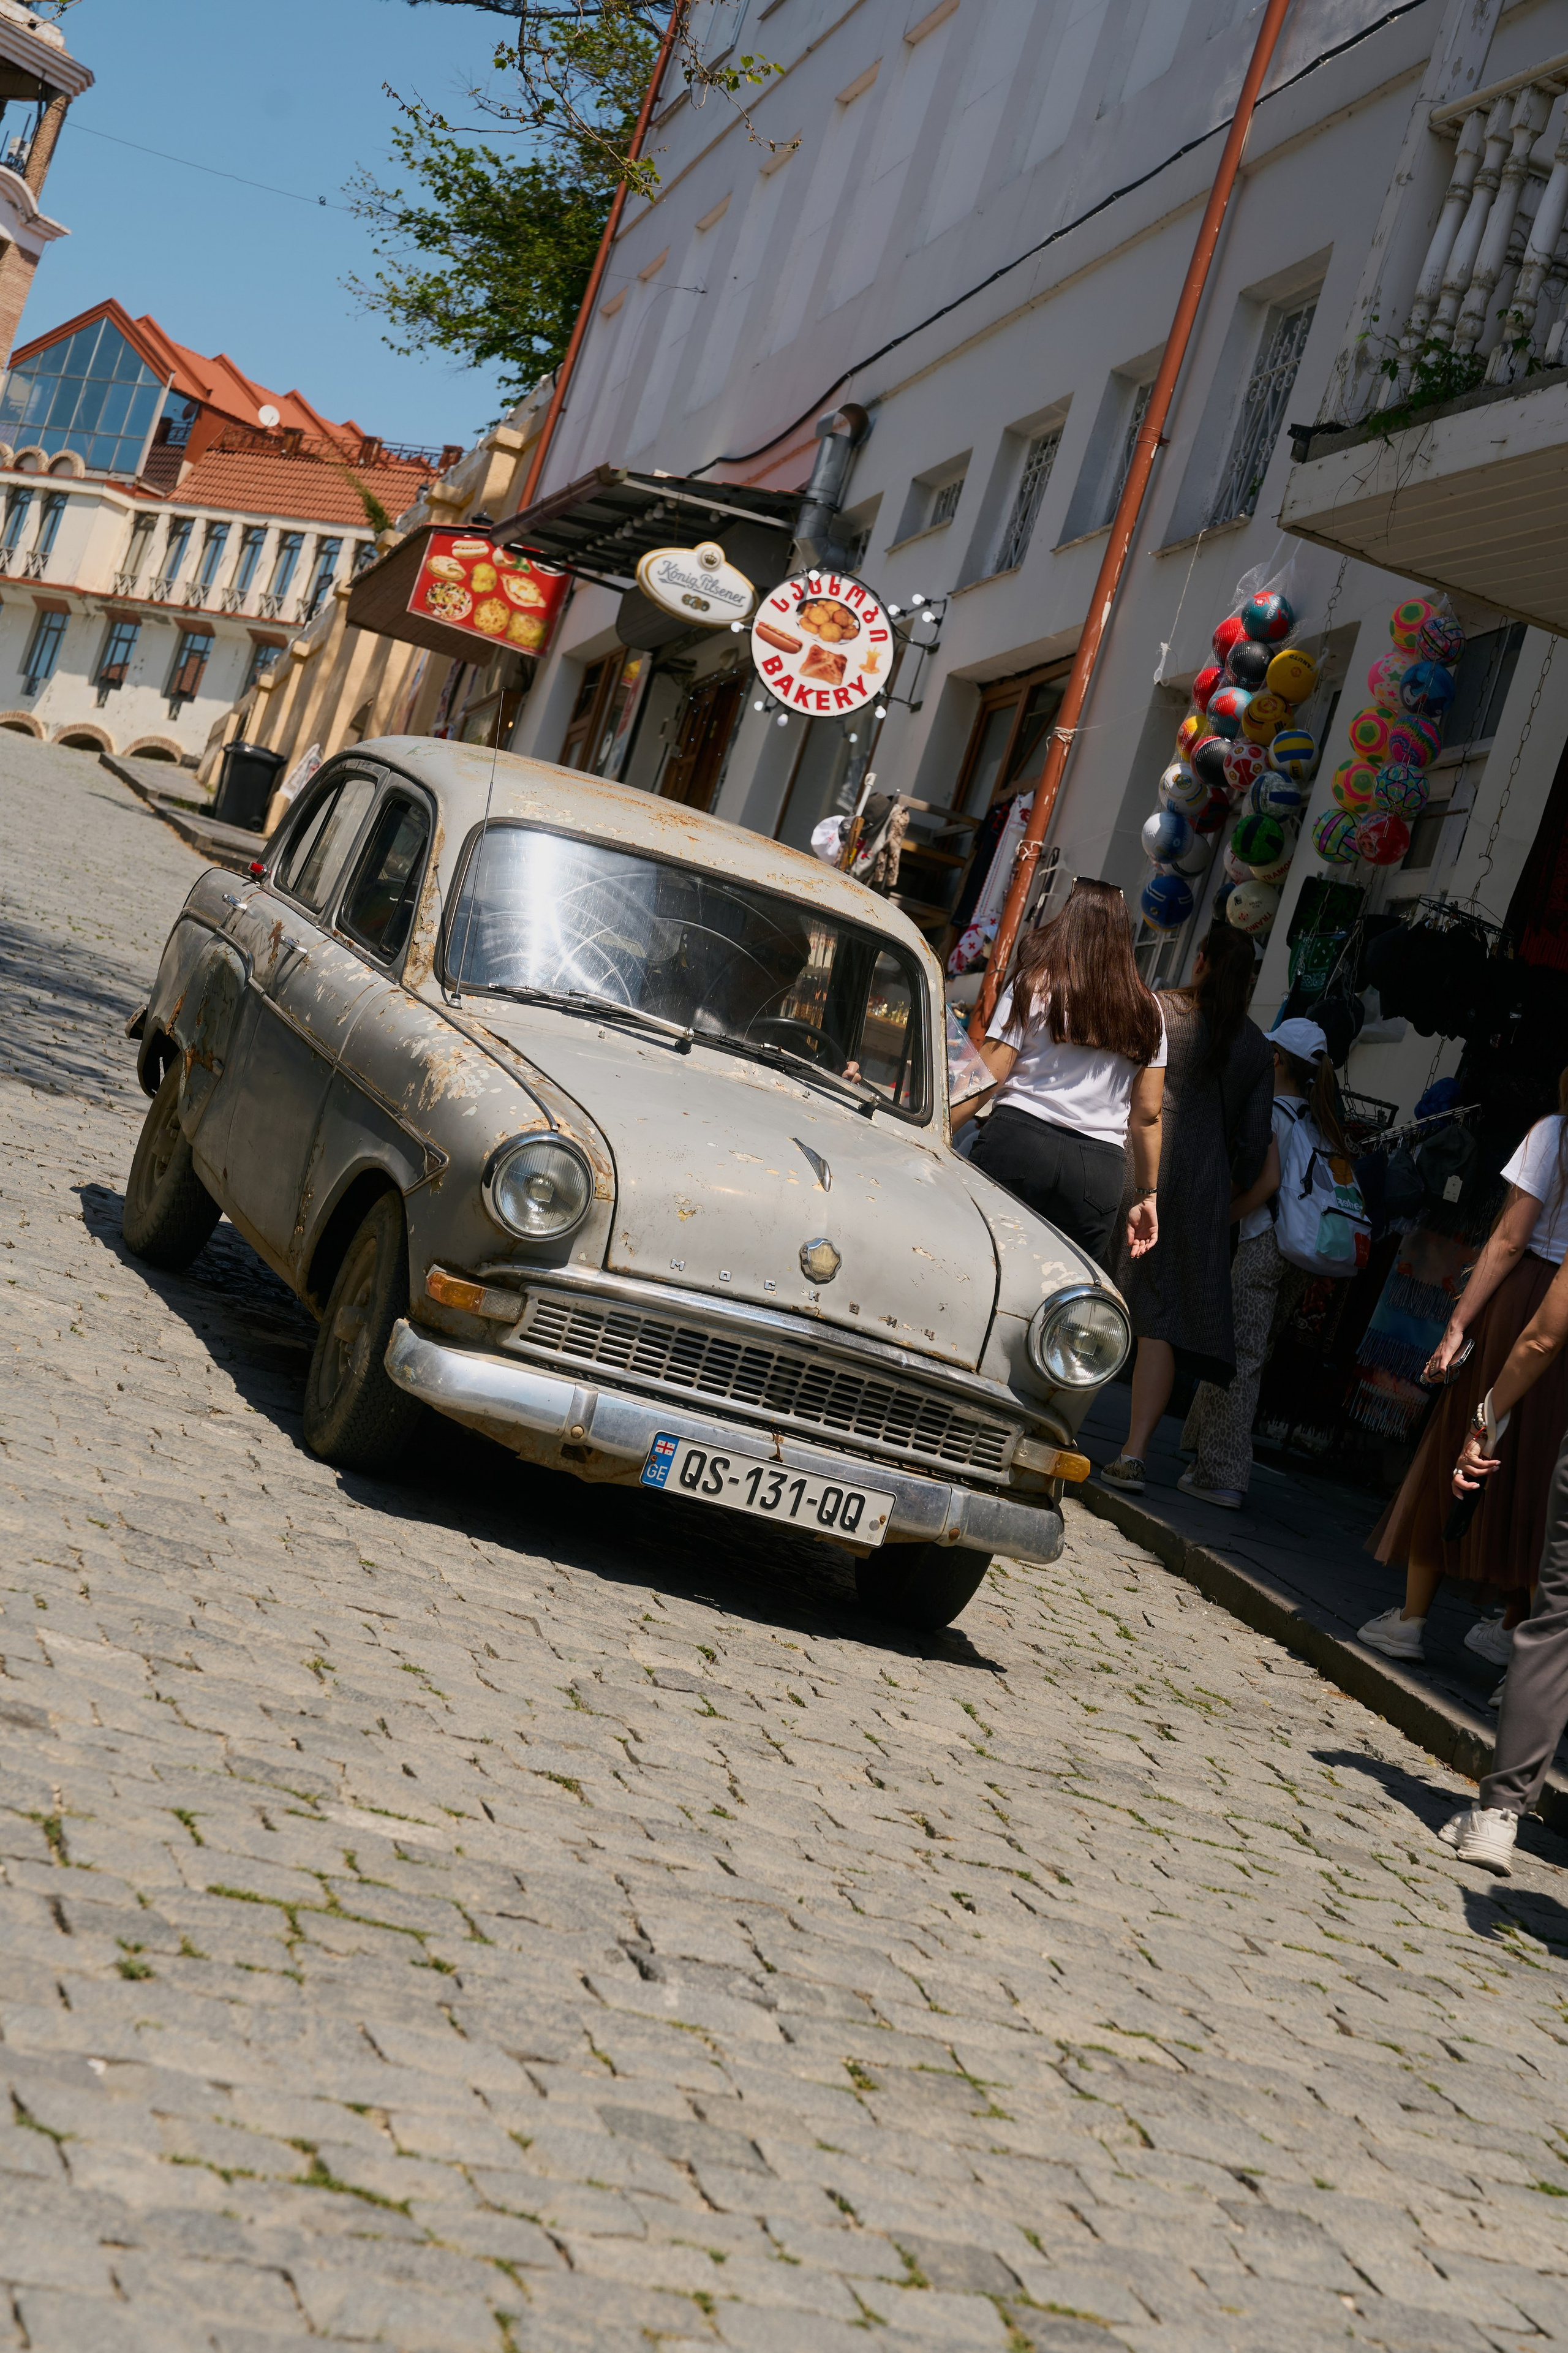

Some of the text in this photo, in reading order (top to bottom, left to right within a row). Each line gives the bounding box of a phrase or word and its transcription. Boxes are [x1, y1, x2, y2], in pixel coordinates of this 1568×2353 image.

[657, 560, 746, 603] König Pilsener
[1289, 654, 1313, 670] ANUTD
[762, 655, 868, 711] BAKERY
[1243, 912, 1273, 933] TRAMO
[647, 1464, 668, 1481] GE
[679, 1449, 866, 1533] QS-131-QQ
